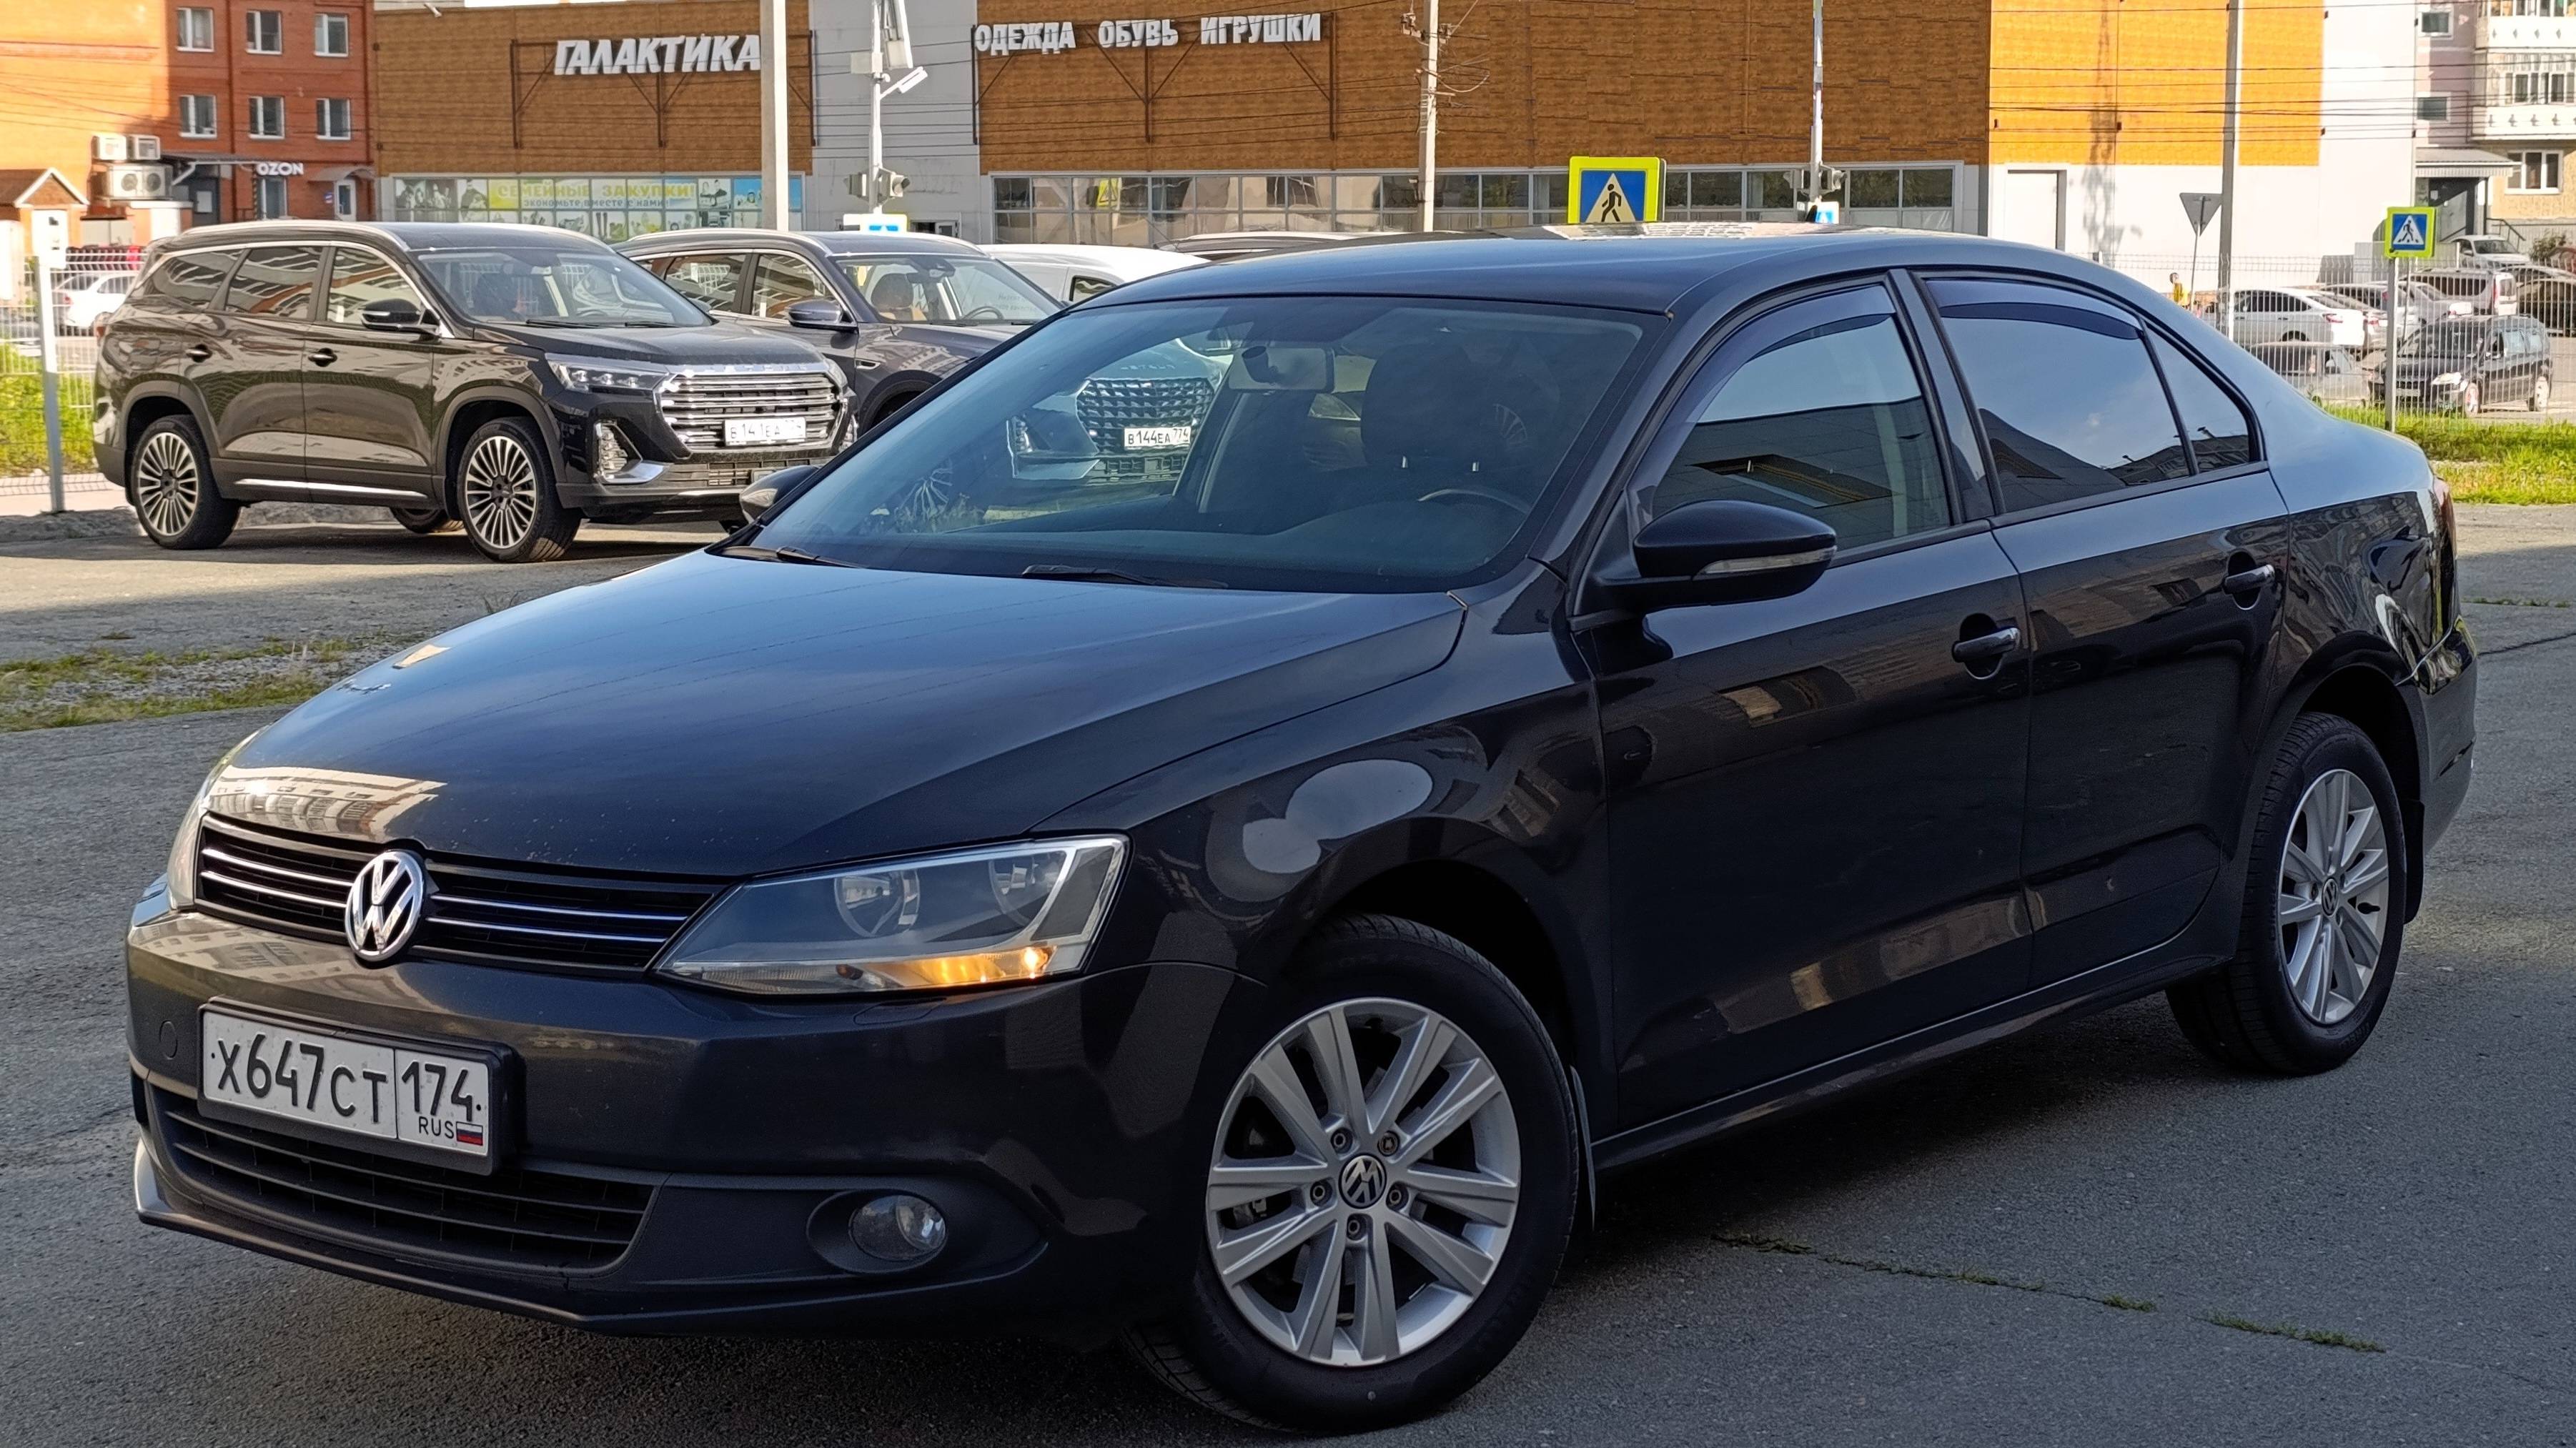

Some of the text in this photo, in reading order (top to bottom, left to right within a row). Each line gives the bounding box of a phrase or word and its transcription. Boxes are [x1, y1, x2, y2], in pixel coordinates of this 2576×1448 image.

[974, 14, 1321, 56] ОДЕЖДА ОБУВЬ ИГРУШКИ
[554, 34, 761, 75] ГАЛАКТИКА
[257, 162, 304, 176] OZON
[497, 182, 588, 197] СЕМЕЙНЫЕ
[217, 1031, 473, 1124] Х647СТ 174
[418, 1116, 455, 1139] RUS
